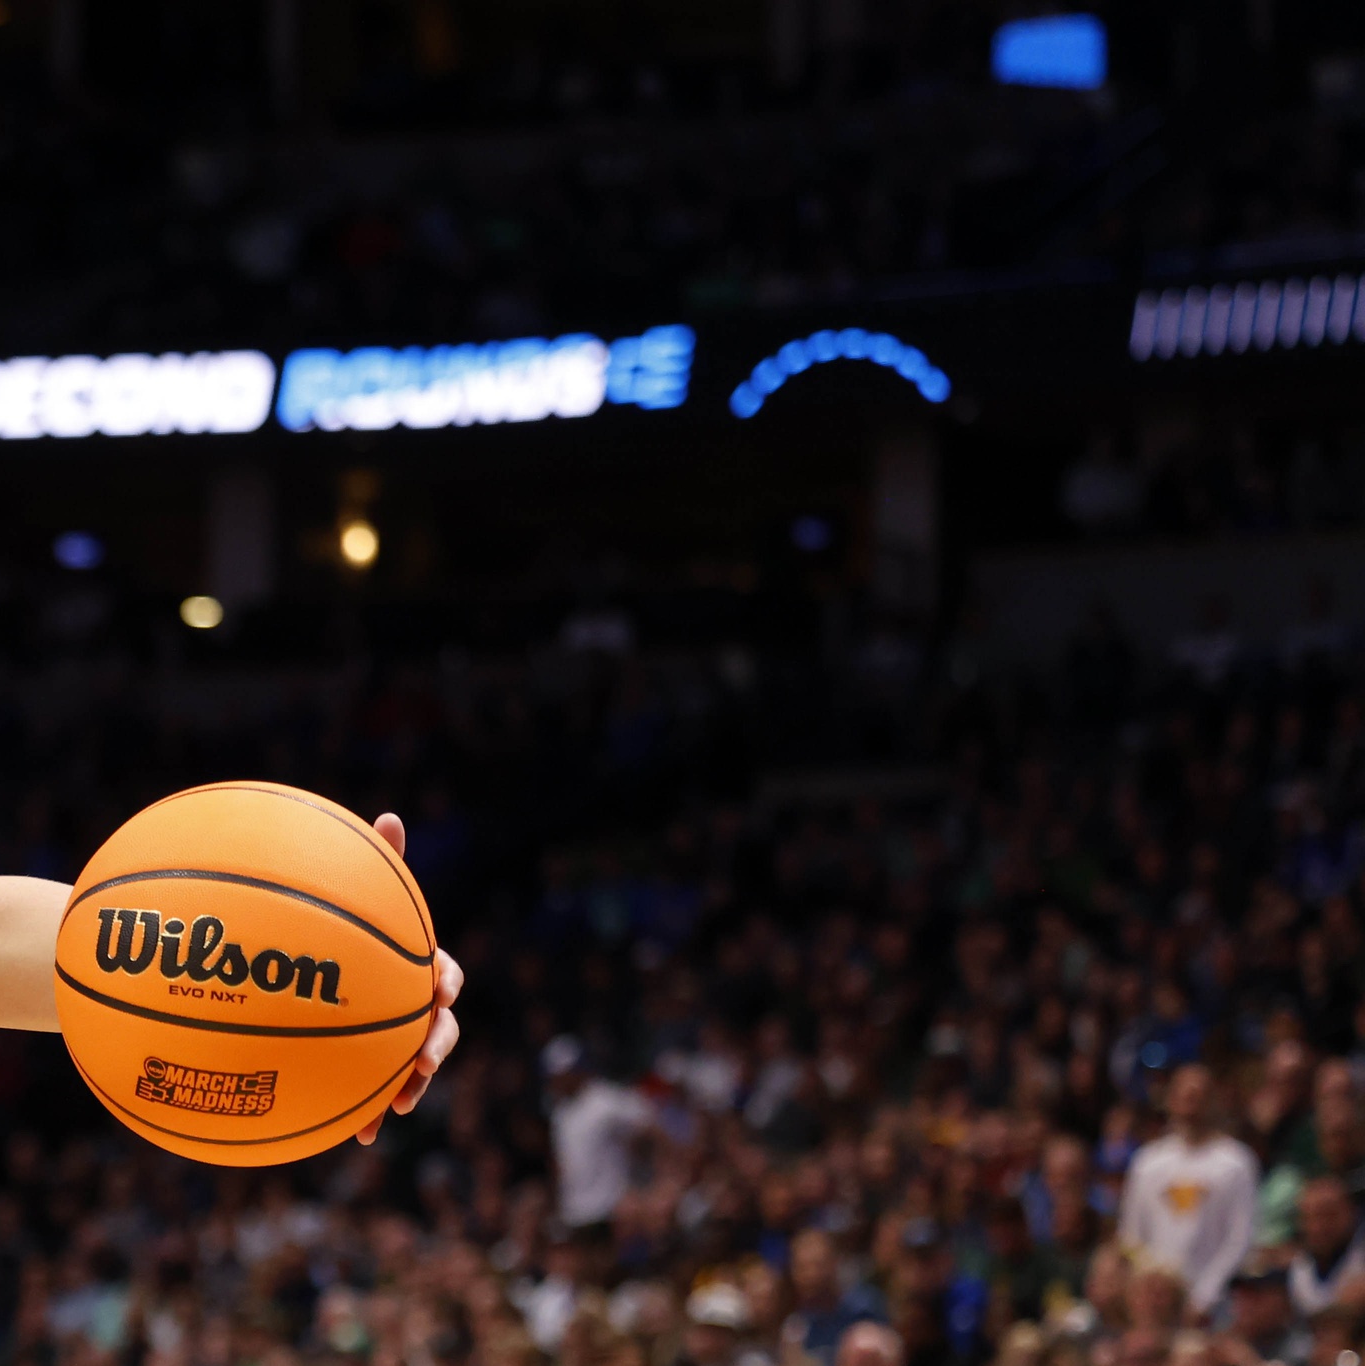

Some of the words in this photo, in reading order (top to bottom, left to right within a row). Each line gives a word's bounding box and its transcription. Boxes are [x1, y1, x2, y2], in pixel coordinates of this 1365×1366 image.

[95, 907, 342, 1007] Wilson
[168, 985, 205, 999] EVO
[210, 990, 248, 1005] NXT
[164, 1064, 239, 1093] MARCH
[172, 1086, 273, 1112] MADNESS
